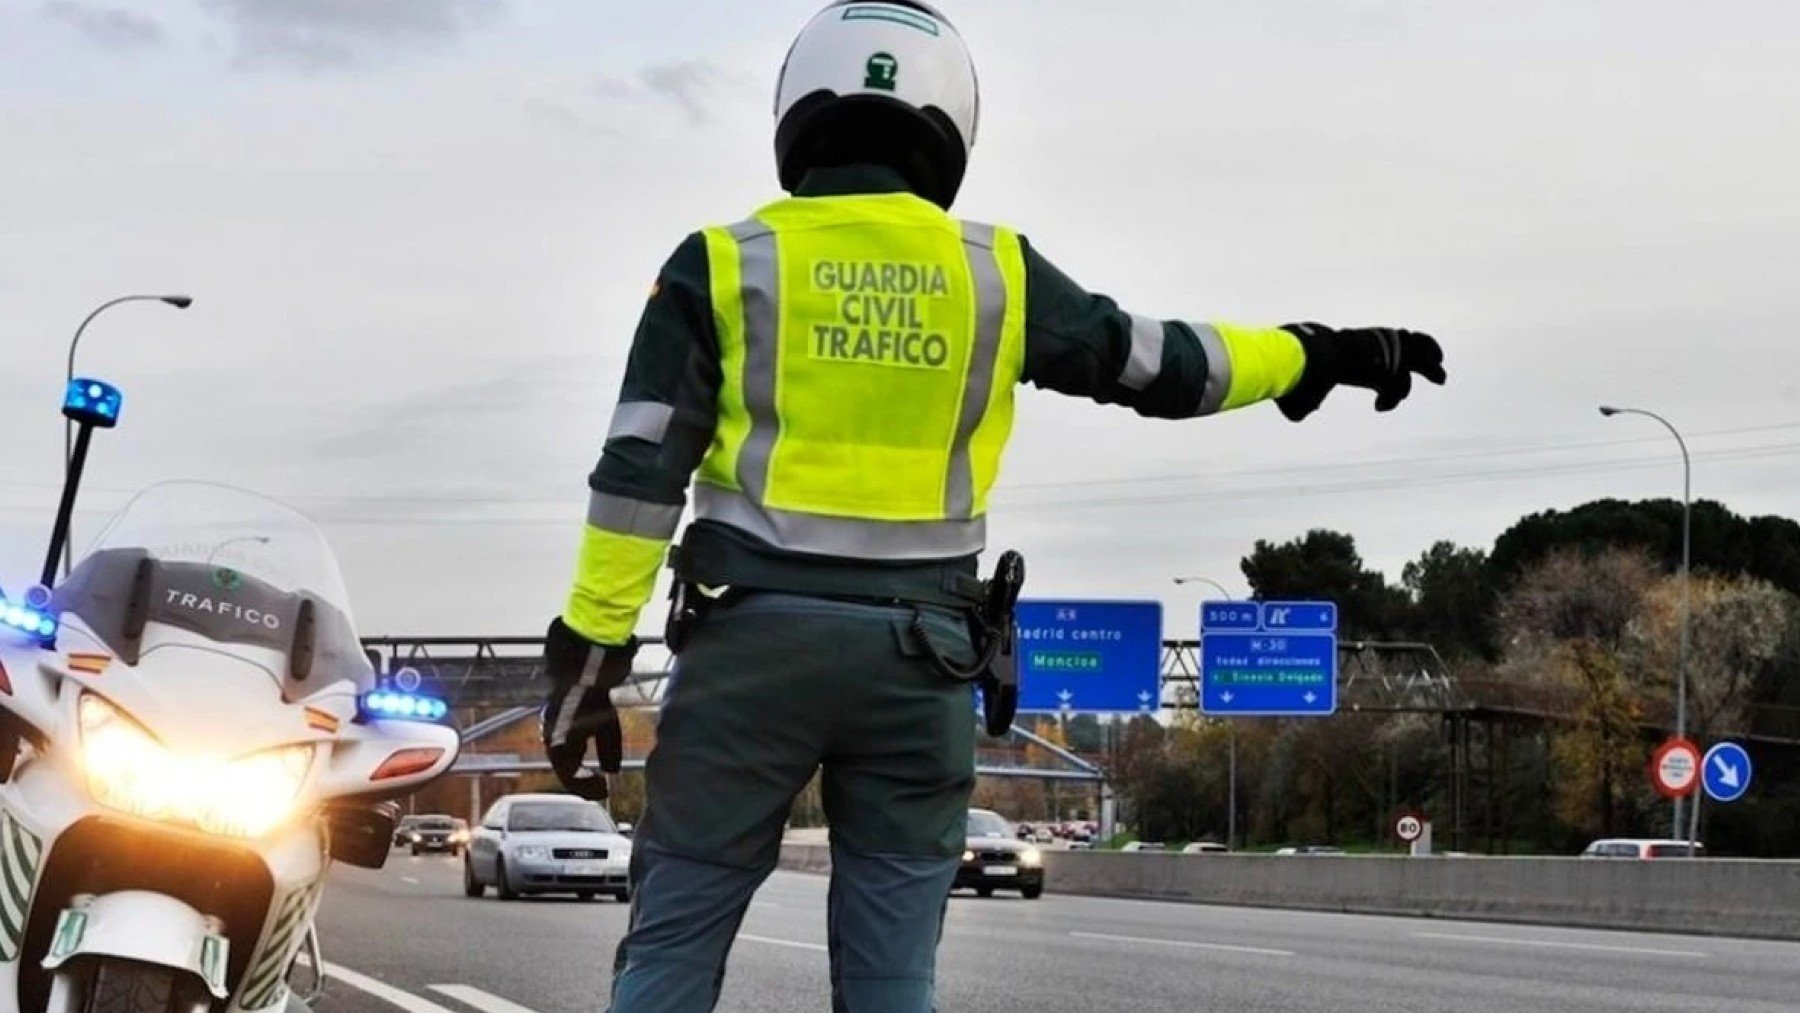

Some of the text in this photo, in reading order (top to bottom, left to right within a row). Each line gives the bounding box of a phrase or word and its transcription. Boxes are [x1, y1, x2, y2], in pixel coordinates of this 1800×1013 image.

[814, 260, 948, 295] GUARDIA
[842, 294, 922, 329] CIVIL
[813, 325, 948, 366] TRAFICO
[166, 588, 280, 630] TRAFICO
[1072, 629, 1122, 640] centro
